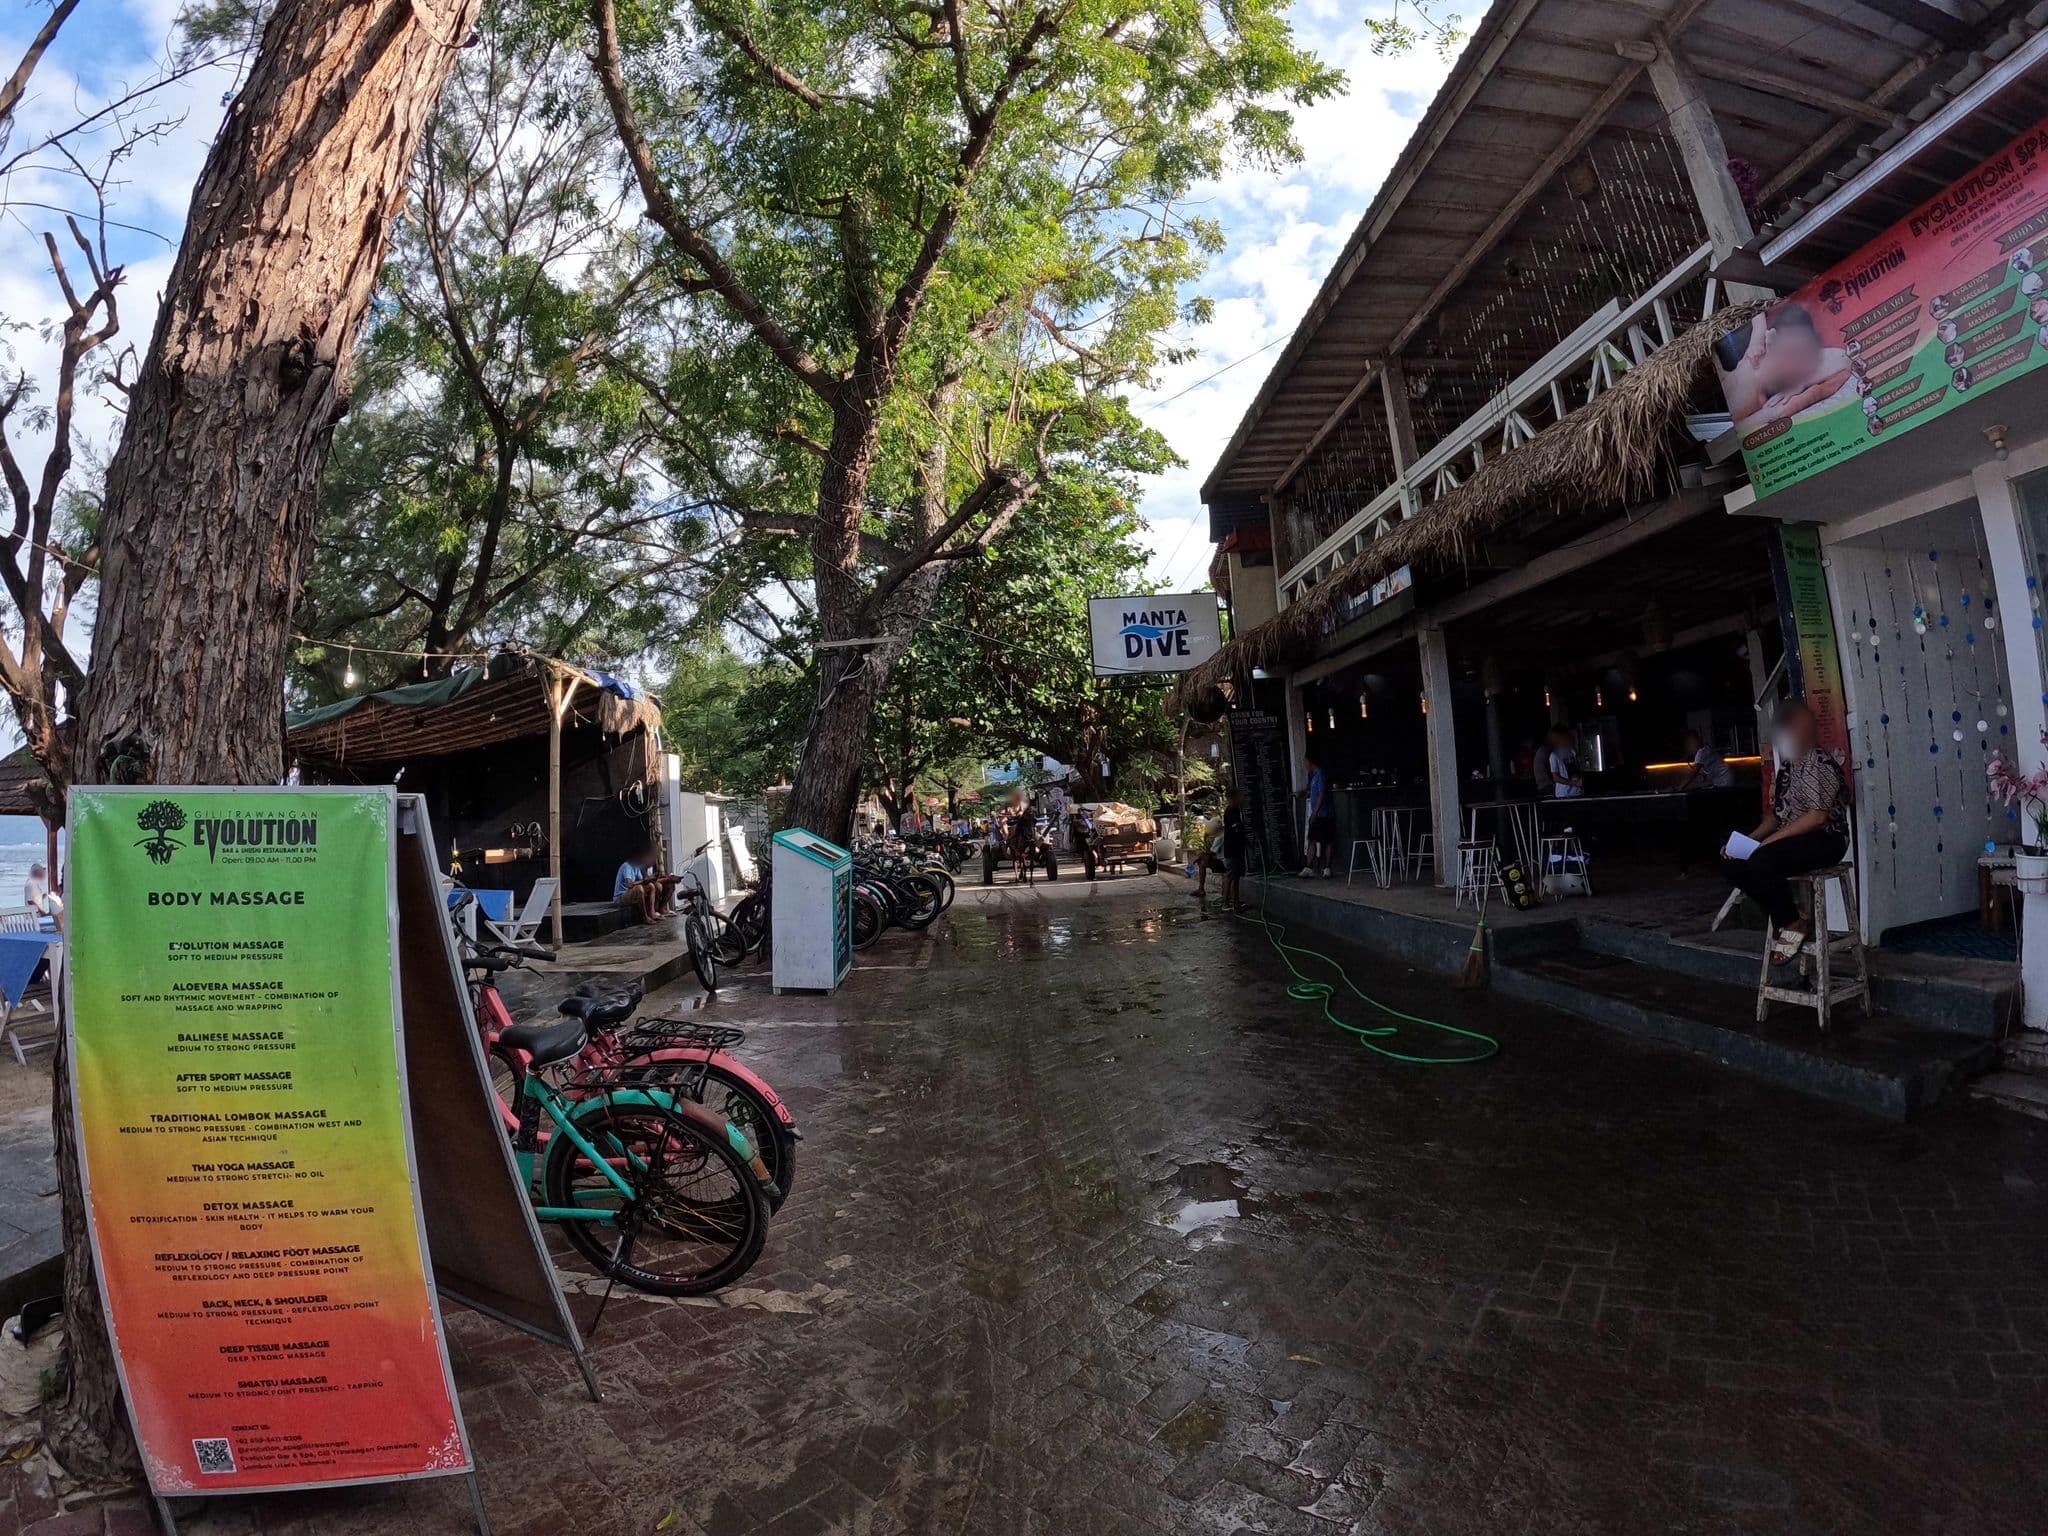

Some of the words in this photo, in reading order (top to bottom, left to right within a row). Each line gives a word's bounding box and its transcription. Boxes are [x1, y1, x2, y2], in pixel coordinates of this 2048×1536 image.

[1968, 195, 1987, 210] BODY
[2023, 162, 2038, 176] AND
[1909, 155, 2014, 238] EVOLUTION
[1844, 248, 1906, 301] EVOLUTION
[1952, 273, 1989, 297] EVOLUTION
[1746, 428, 1776, 447] CONTACT
[1777, 422, 1785, 431] US
[1123, 609, 1187, 626] MANTA
[1125, 629, 1190, 659] DIVE
[194, 819, 316, 864] EVOLUTION
[149, 892, 202, 905] BODY
[210, 891, 304, 905] MASSAGE
[169, 942, 229, 950] EVOLUTION
[233, 941, 284, 949] MASSAGE
[173, 983, 228, 991] ALOEVERA
[232, 982, 283, 990] MASSAGE
[178, 1033, 228, 1041] BALINESE
[232, 1032, 283, 1040] MASSAGE
[210, 1073, 241, 1081] SPORT
[244, 1072, 291, 1080] MASSAGE
[150, 1114, 221, 1122] TRADITIONAL
[225, 1113, 271, 1121] LOMBOK
[275, 1110, 326, 1119] MASSAGE
[255, 1123, 314, 1131] COMBINATION
[247, 1161, 295, 1170] MASSAGE
[203, 1203, 239, 1211] DETOX
[243, 1200, 294, 1209] MASSAGE
[155, 1253, 222, 1261] REFLEXOLOGY
[232, 1250, 280, 1259] RELAXING
[283, 1248, 309, 1257] FOOT
[312, 1245, 360, 1255] MASSAGE
[290, 1258, 349, 1266] COMBINATION
[278, 1269, 320, 1277] PRESSURE
[202, 1300, 232, 1308] BACK,
[234, 1299, 263, 1307] NECK,
[274, 1295, 328, 1305] SHOULDER
[292, 1304, 350, 1313] REFLEXOLOGY
[246, 1344, 280, 1352] TISSUE
[283, 1341, 329, 1350] MASSAGE
[238, 1380, 278, 1388] SHIATSU
[280, 1376, 327, 1385] MASSAGE
[299, 1385, 339, 1393] PRESSING
[348, 1381, 383, 1389] TAPPING
